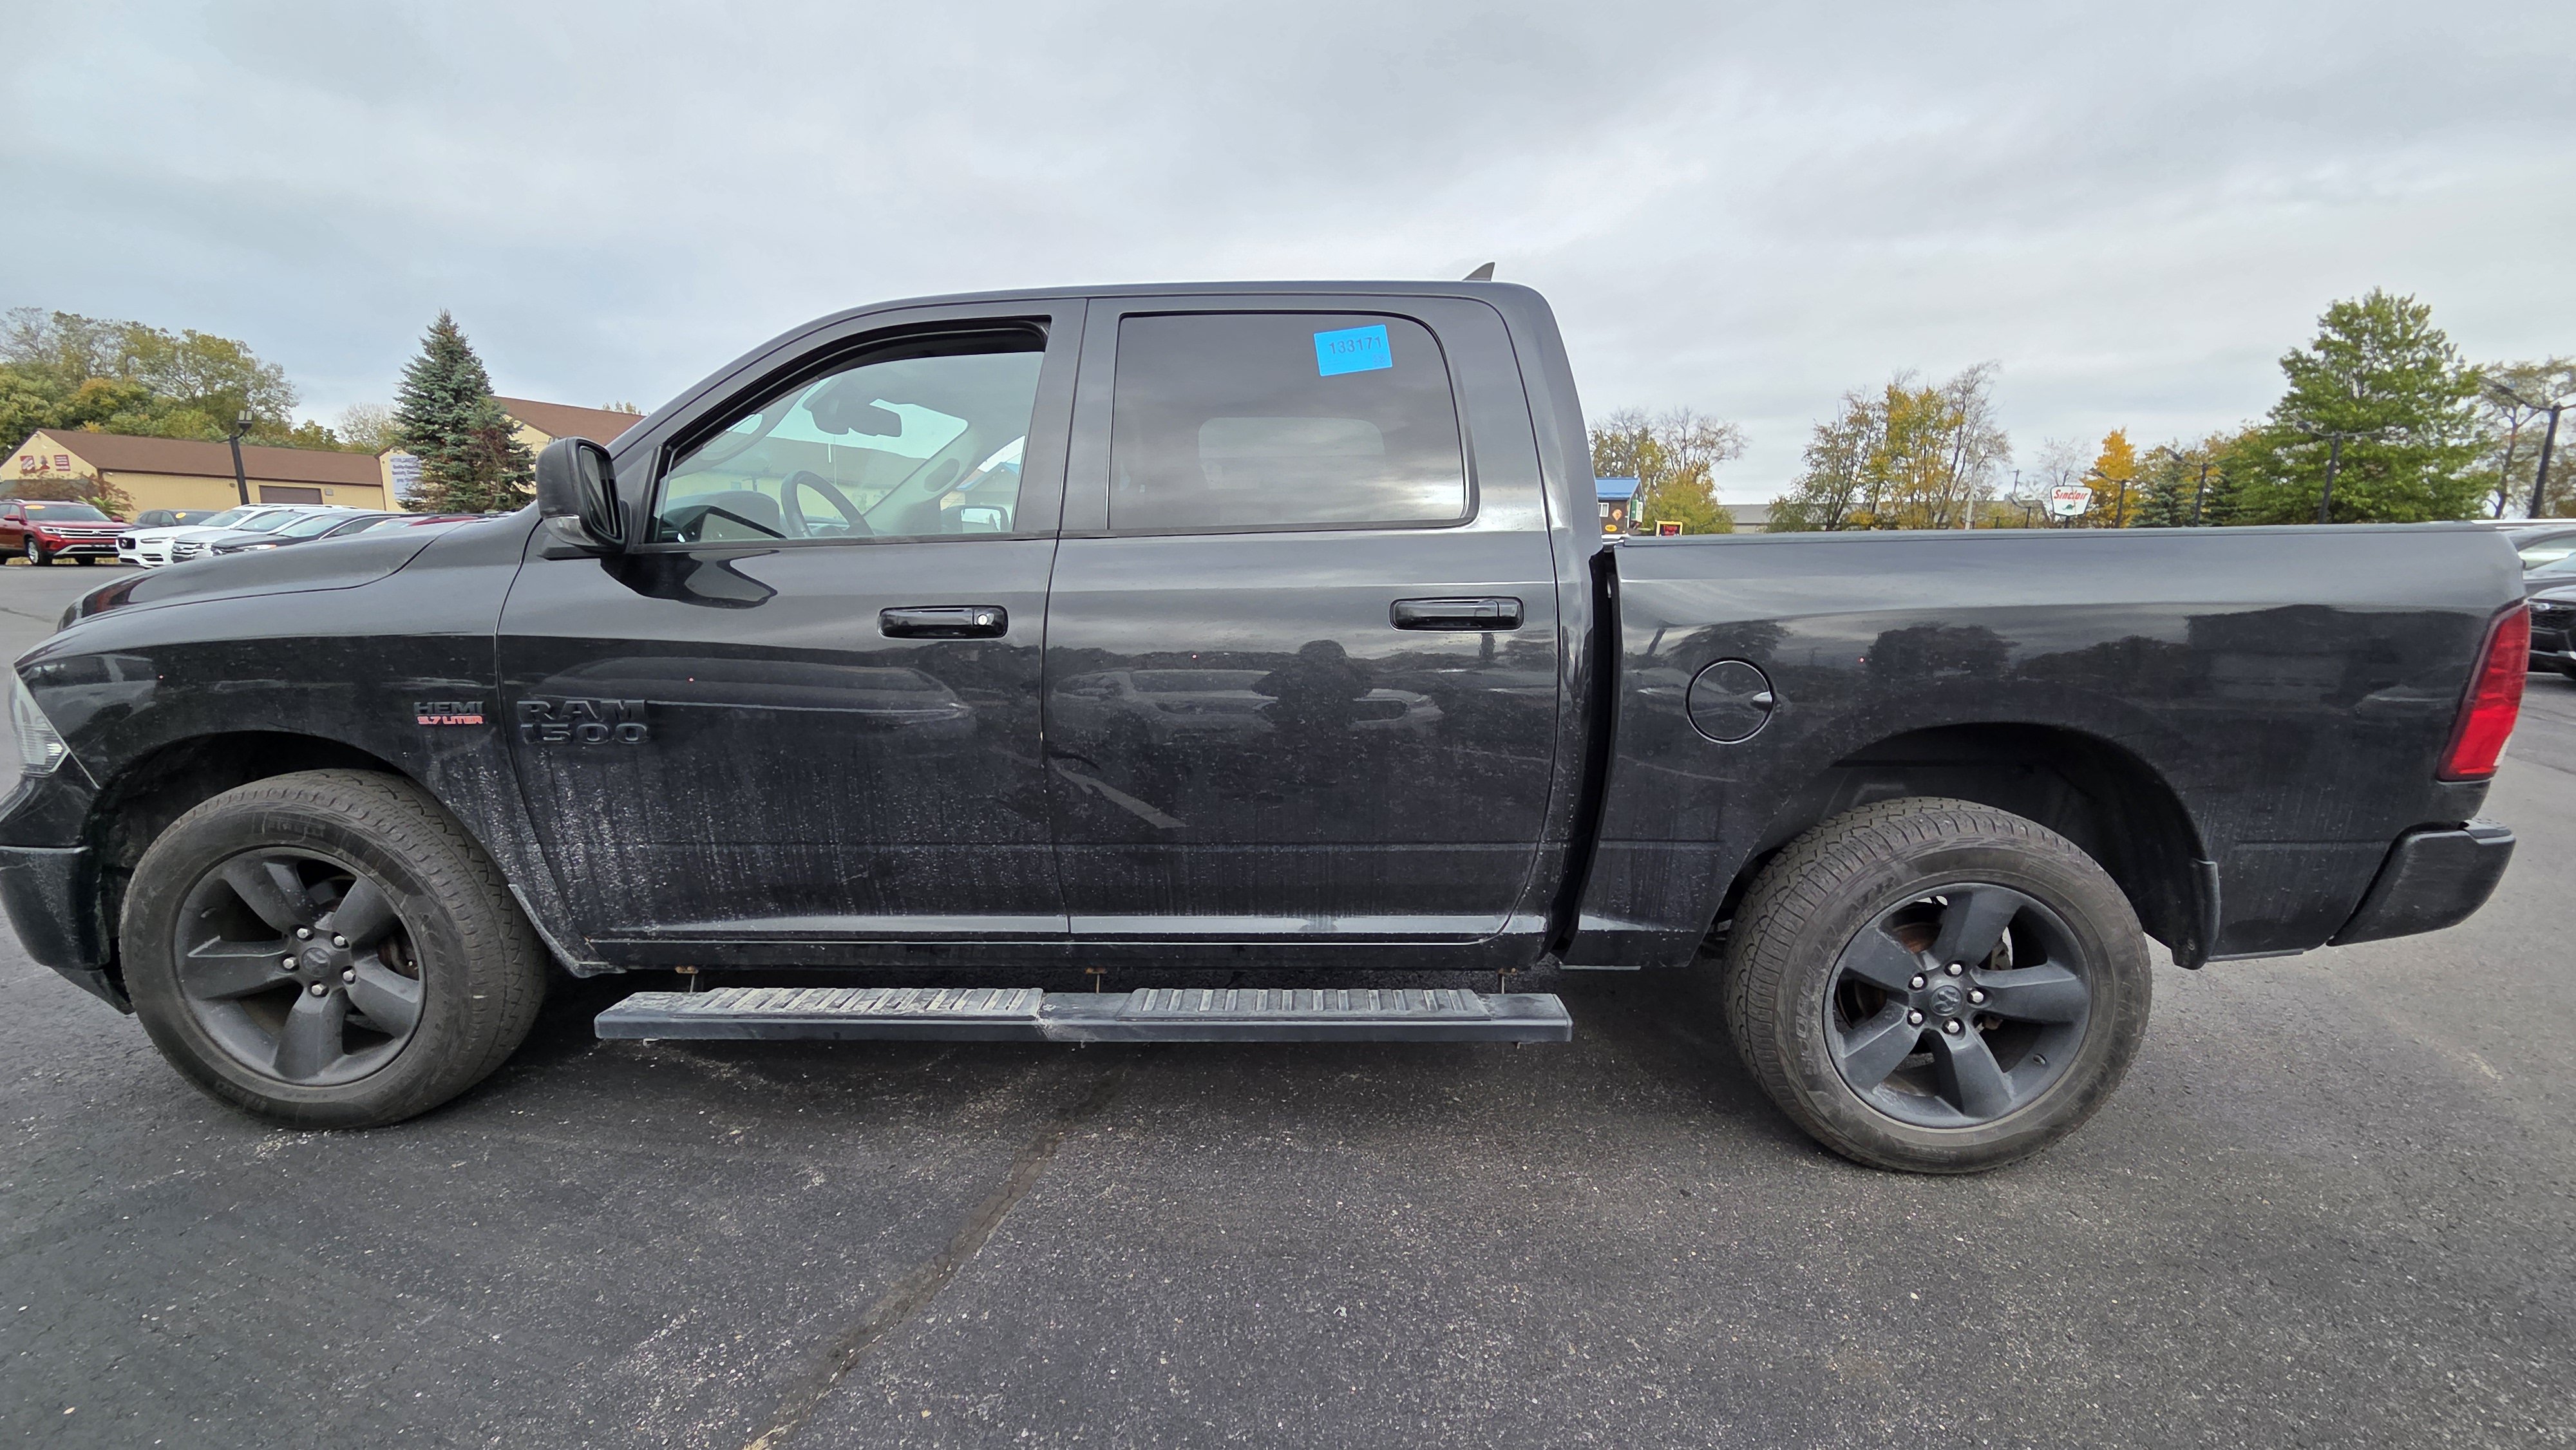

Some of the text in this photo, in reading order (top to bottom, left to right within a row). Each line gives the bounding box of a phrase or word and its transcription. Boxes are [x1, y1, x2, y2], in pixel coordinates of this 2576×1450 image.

[1329, 336, 1382, 355] 133171
[2054, 489, 2088, 500] Sinclair
[413, 701, 484, 715] HEMI
[516, 700, 645, 721] RAM
[417, 715, 483, 724] 5.7 LITER
[520, 722, 649, 744] 1500
